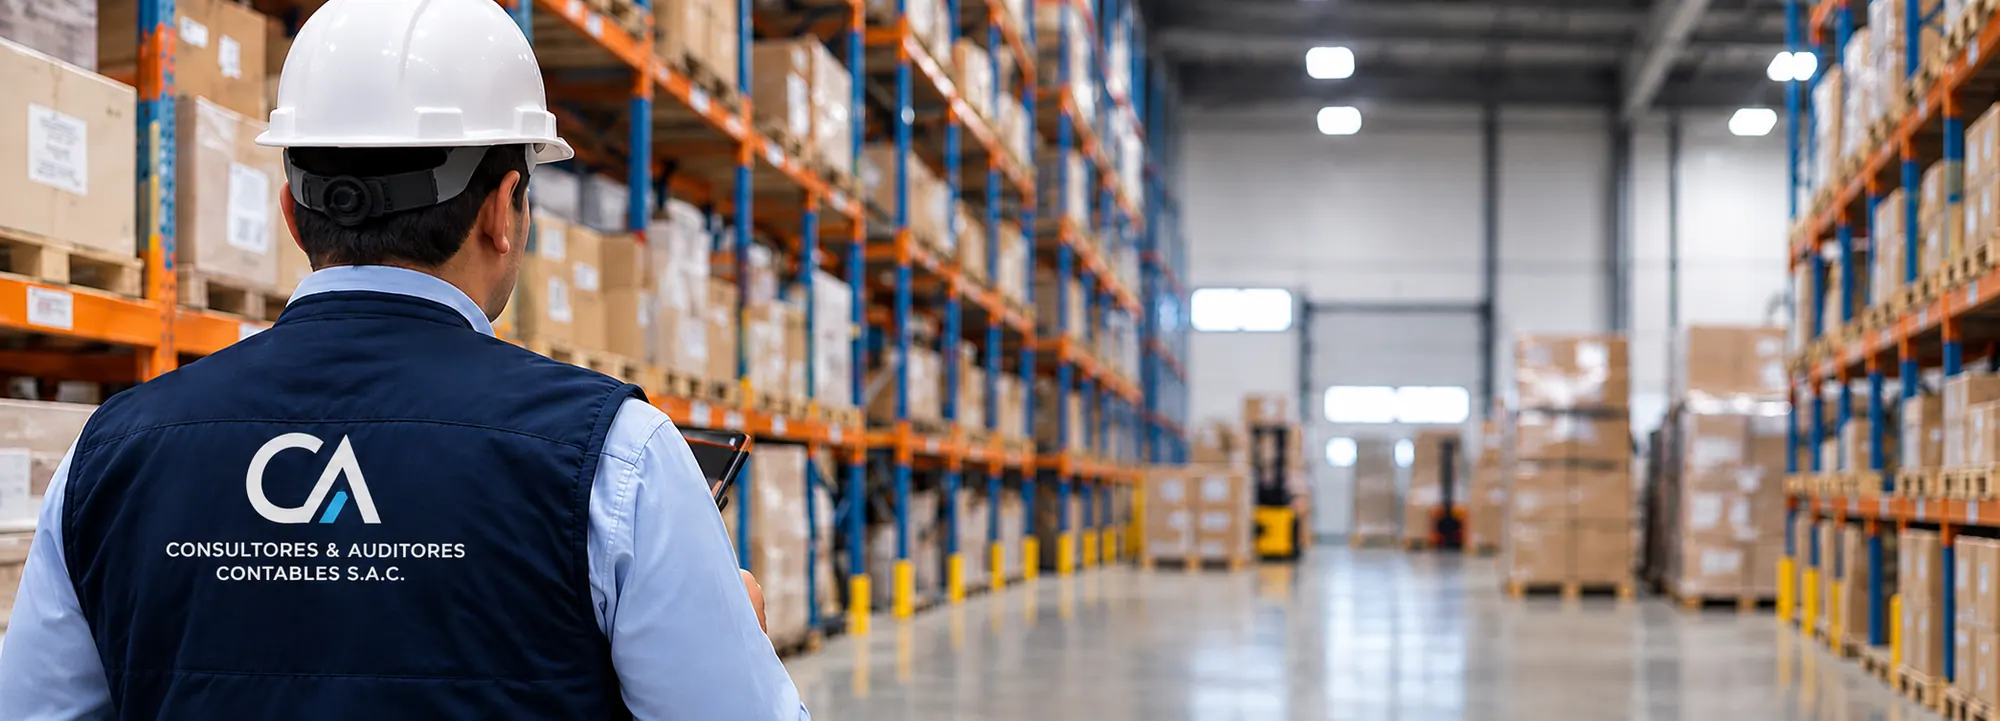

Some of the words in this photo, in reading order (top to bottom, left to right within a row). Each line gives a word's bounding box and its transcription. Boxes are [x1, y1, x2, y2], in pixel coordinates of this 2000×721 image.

[246, 433, 381, 523] CA
[166, 542, 318, 557] CONSULTORES
[326, 543, 339, 557] &
[348, 543, 465, 558] AUDITORES
[217, 566, 339, 581] CONTABLES
[348, 566, 404, 581] S.A.C.
